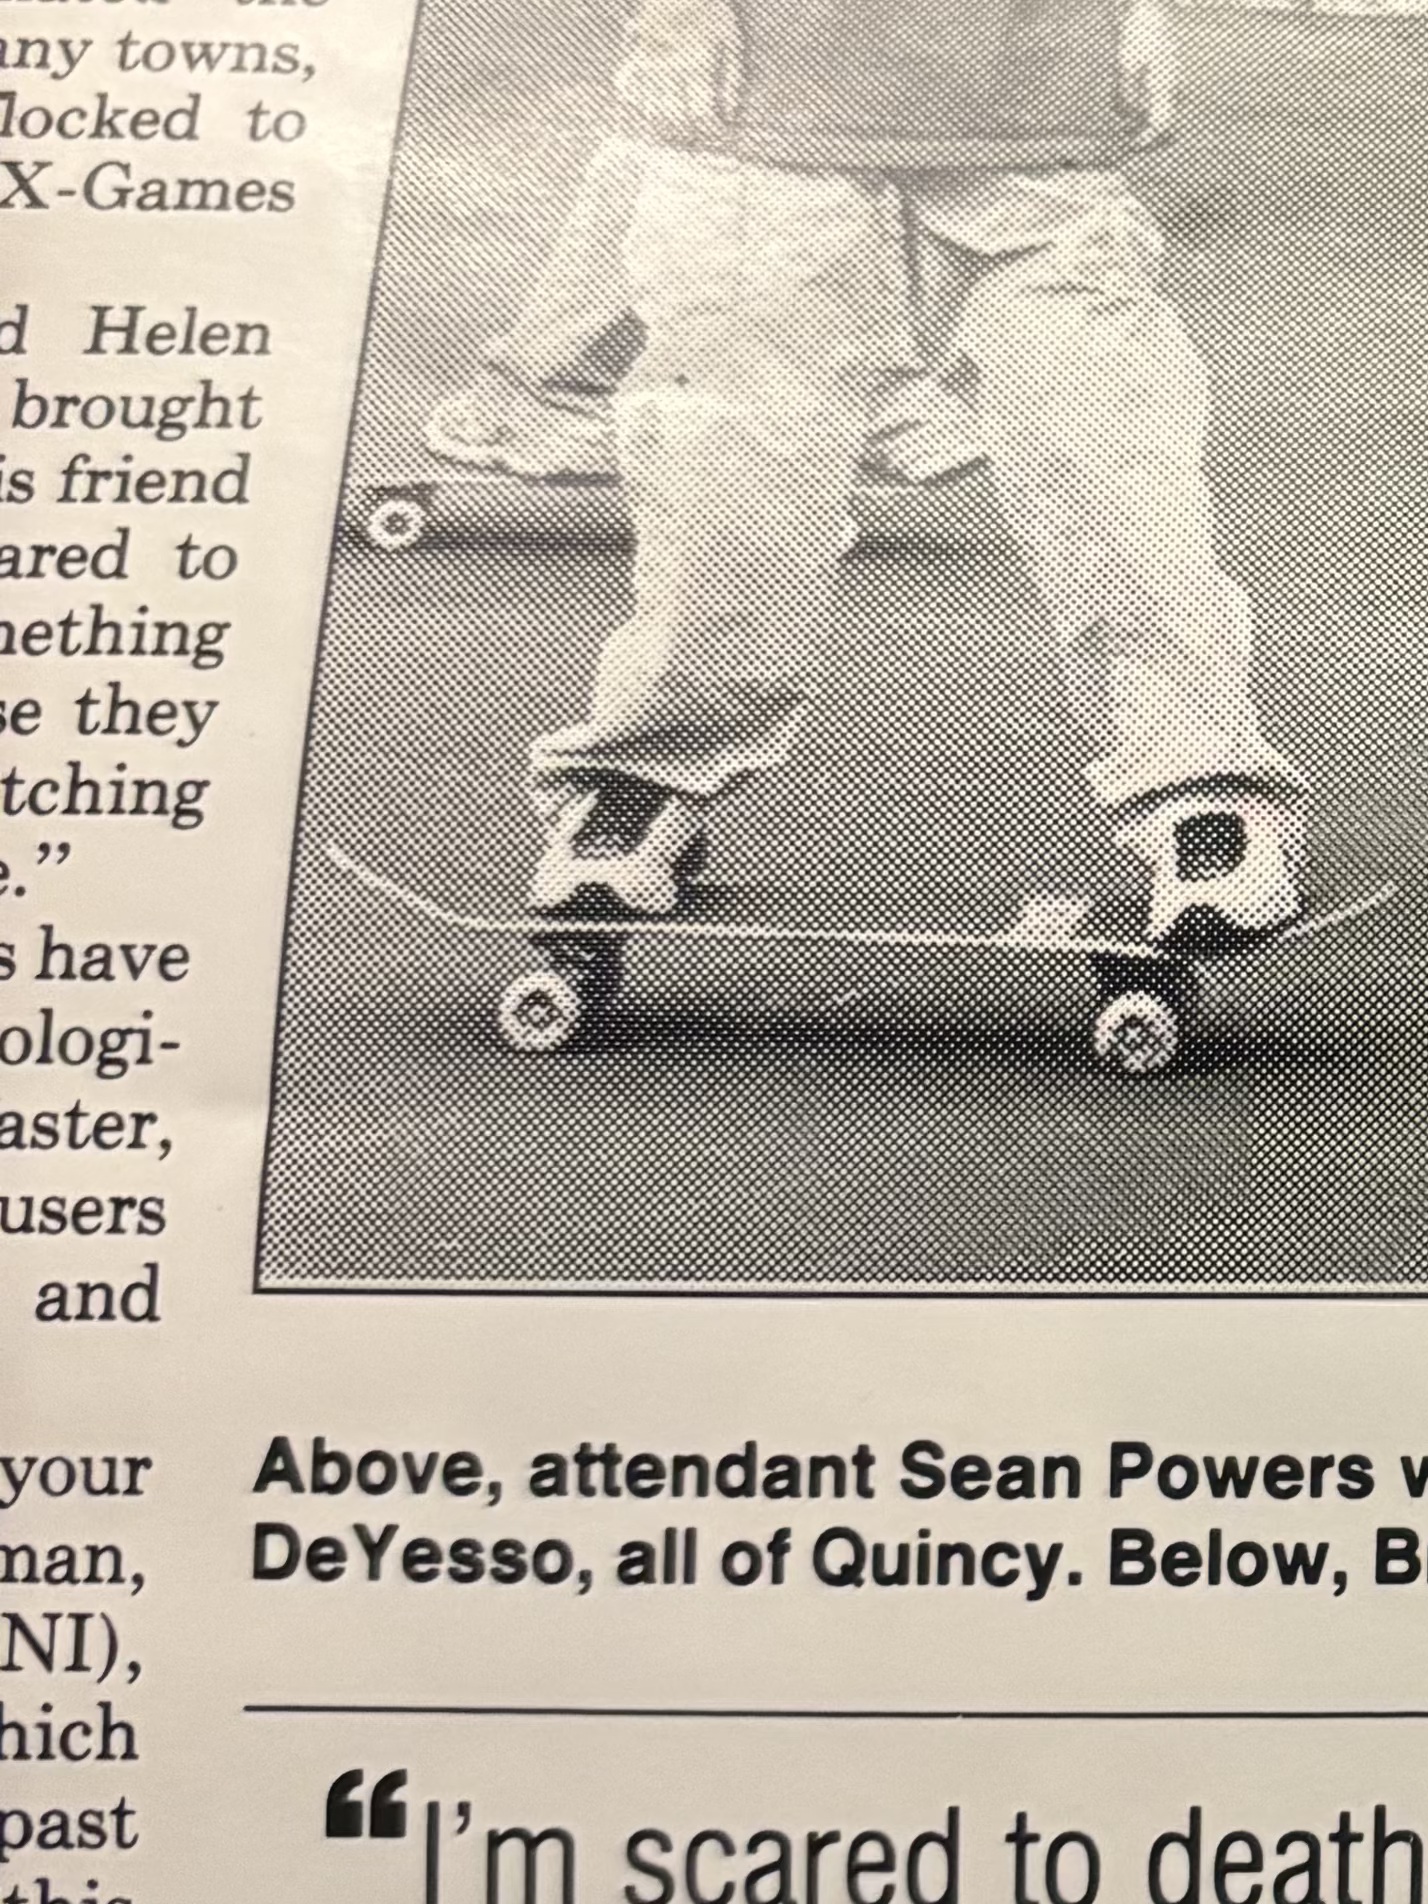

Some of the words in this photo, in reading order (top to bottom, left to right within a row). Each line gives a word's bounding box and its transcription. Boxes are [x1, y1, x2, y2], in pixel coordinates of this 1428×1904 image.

[0, 156, 295, 214] X-Games
[12, 377, 263, 442] brought
[252, 1436, 501, 1506] Above,
[529, 1441, 875, 1500] attendant
[900, 1440, 1080, 1500] Sean
[1110, 1442, 1374, 1500] Powers
[252, 1522, 591, 1595] DeYesso,
[617, 1527, 696, 1586] all
[722, 1527, 791, 1586] of
[813, 1527, 1081, 1601] Quincy.
[1110, 1528, 1347, 1597] Below,
